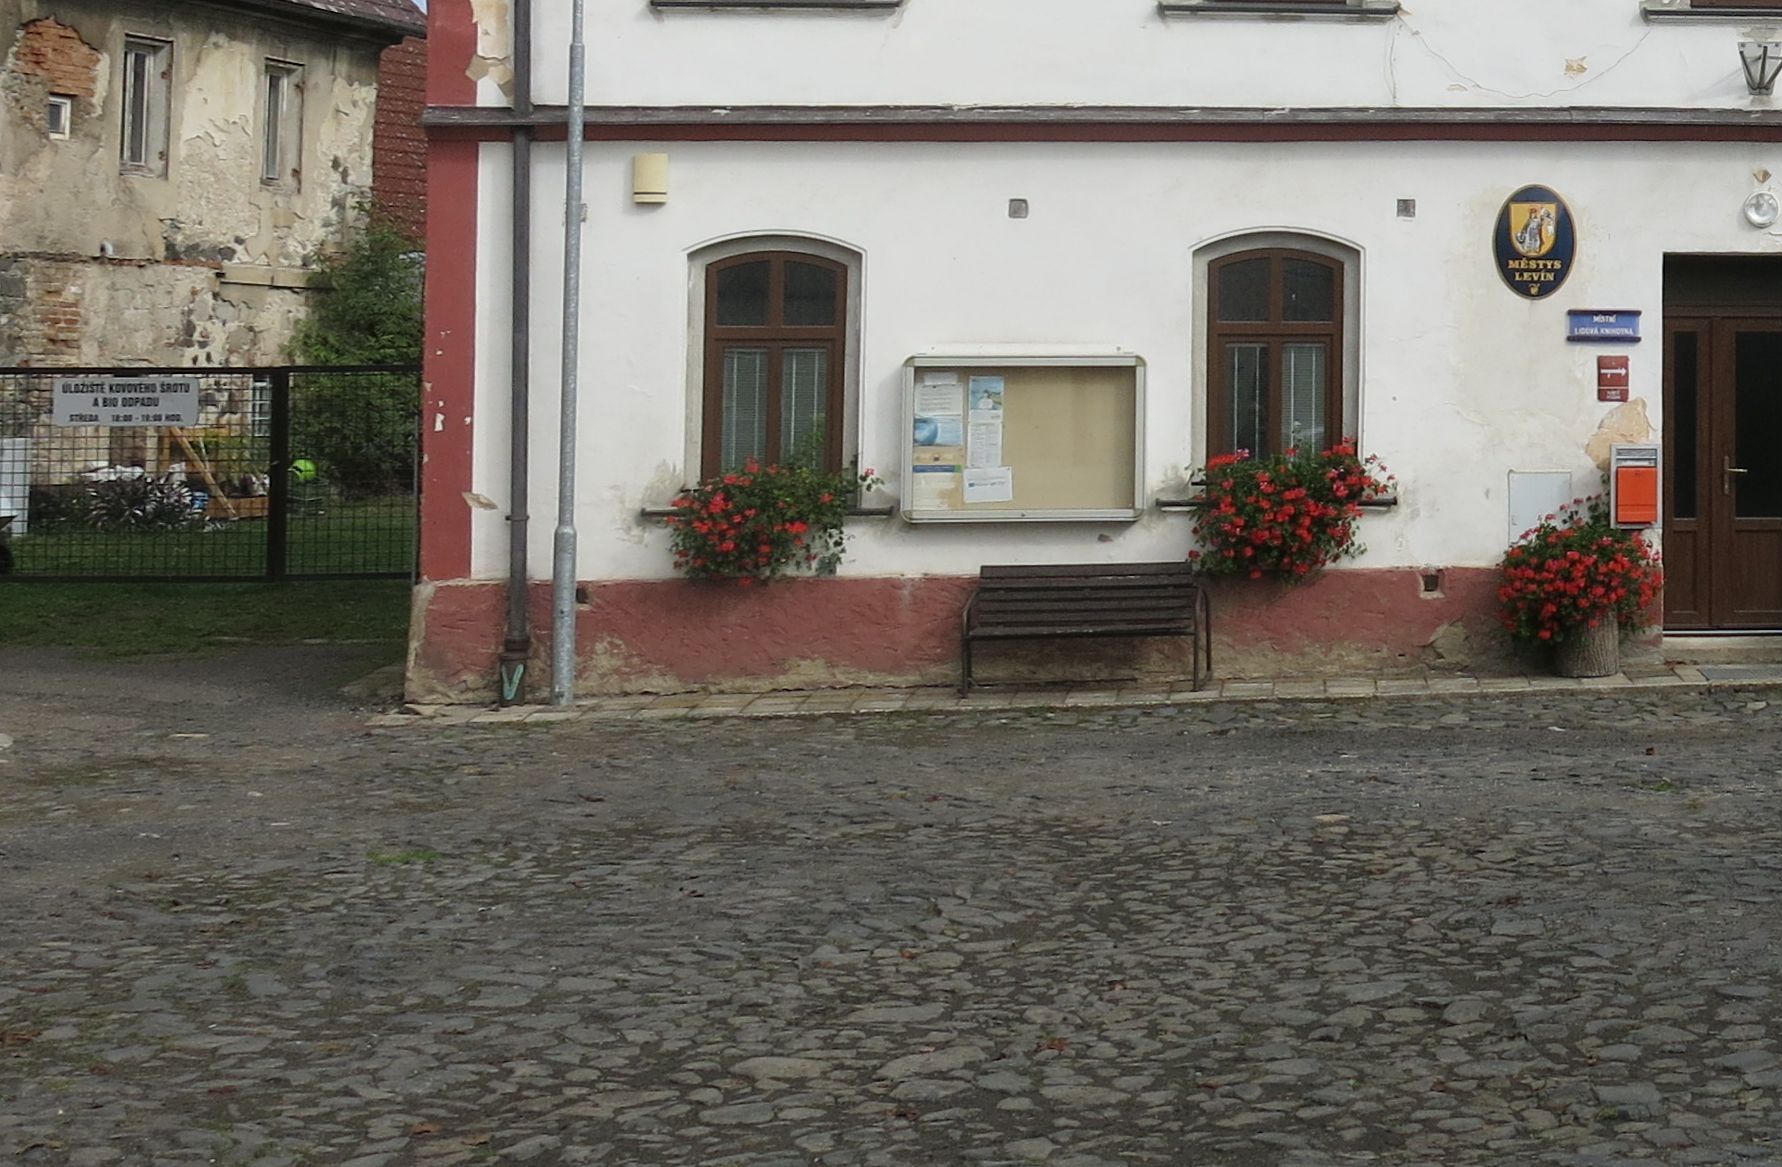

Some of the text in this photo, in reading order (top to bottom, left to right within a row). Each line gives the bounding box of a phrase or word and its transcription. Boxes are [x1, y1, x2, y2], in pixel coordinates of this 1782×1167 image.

[1507, 257, 1562, 269] MĚSTYS
[1515, 269, 1555, 281] LEVÍN
[160, 381, 190, 394] ŠROTU
[92, 396, 160, 408] A BIO ODPADU
